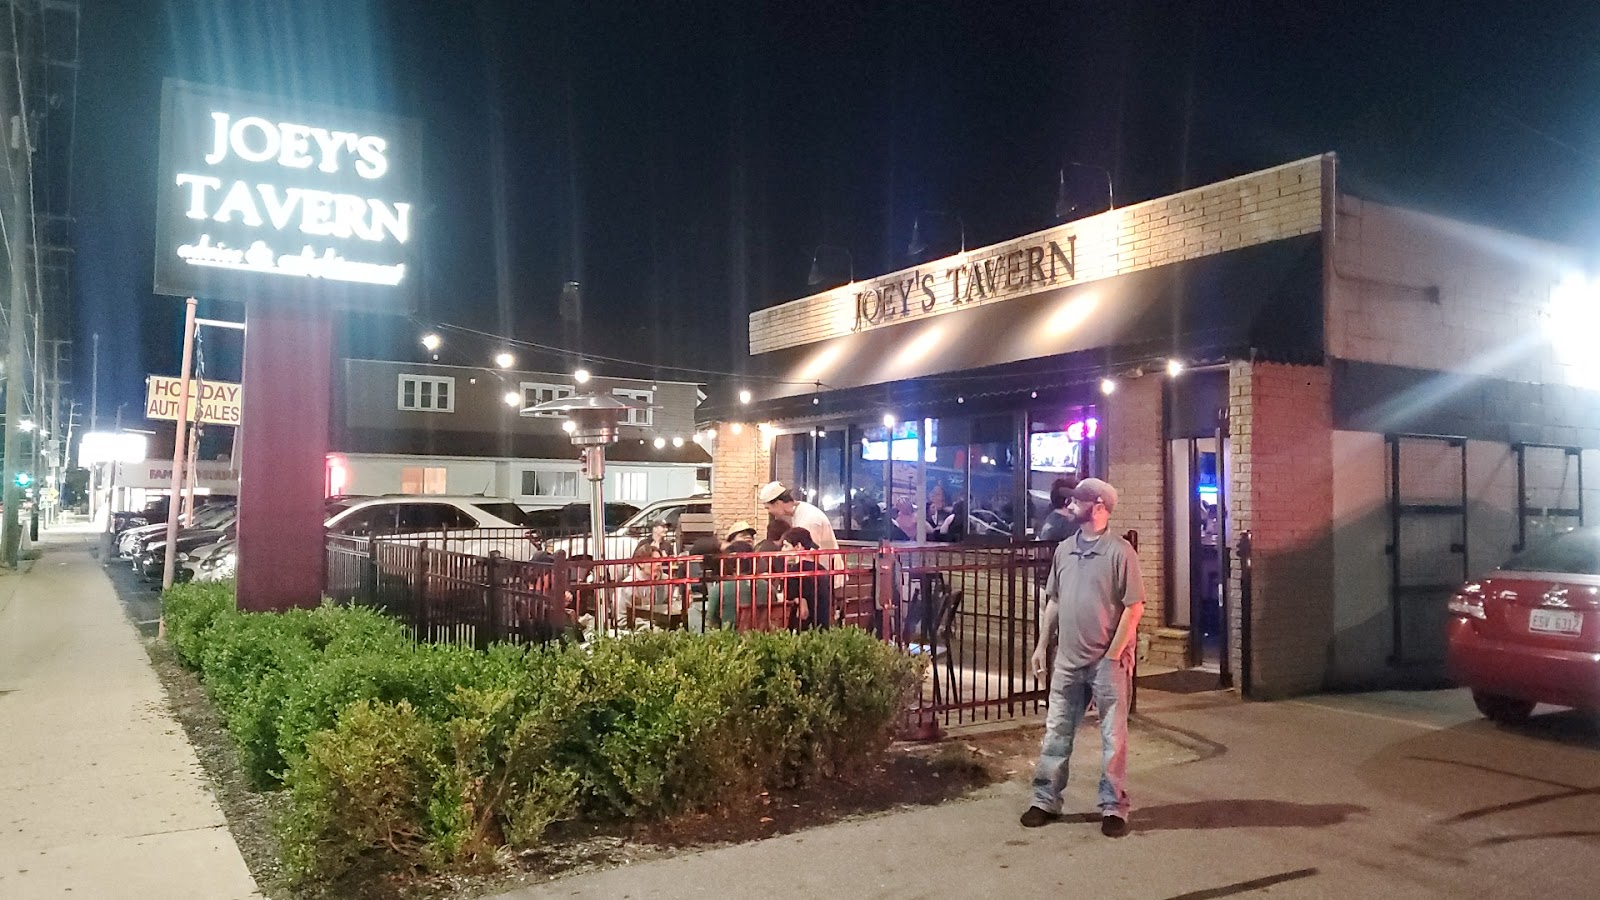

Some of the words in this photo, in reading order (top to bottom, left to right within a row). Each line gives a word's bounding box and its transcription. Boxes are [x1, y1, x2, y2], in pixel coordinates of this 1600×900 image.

[206, 112, 388, 179] JOEY'S
[176, 173, 410, 244] TAVERN
[851, 270, 936, 332] JOEY'S
[946, 235, 1077, 305] TAVERN
[149, 399, 181, 418] AUT
[155, 380, 239, 402] HODAY
